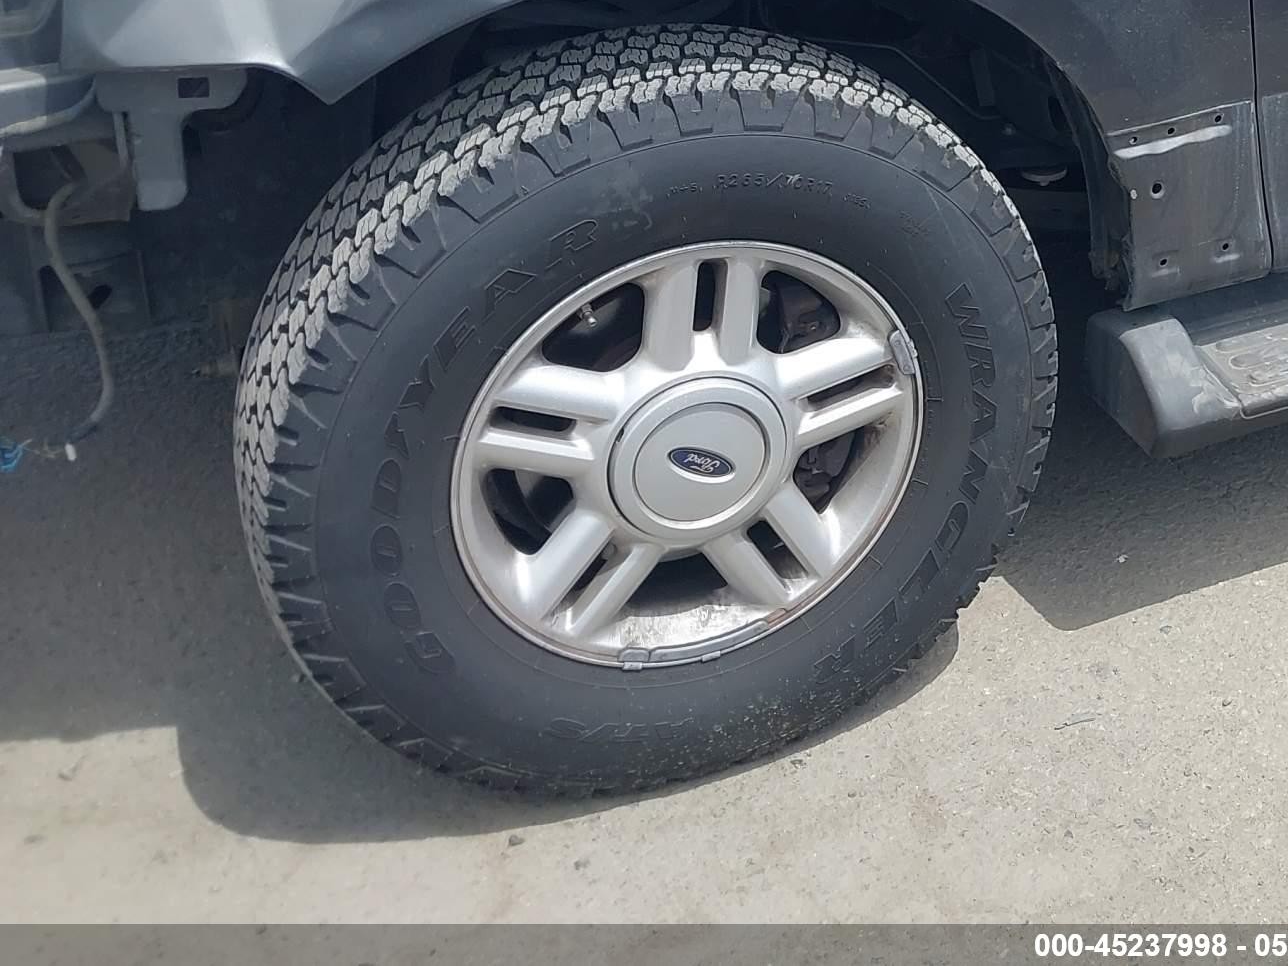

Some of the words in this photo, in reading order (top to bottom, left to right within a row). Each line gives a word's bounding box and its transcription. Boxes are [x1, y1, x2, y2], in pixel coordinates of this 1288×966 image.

[370, 218, 600, 674] GOODYEAR
[684, 453, 721, 474] Ford
[812, 281, 999, 685] WRANGLER
